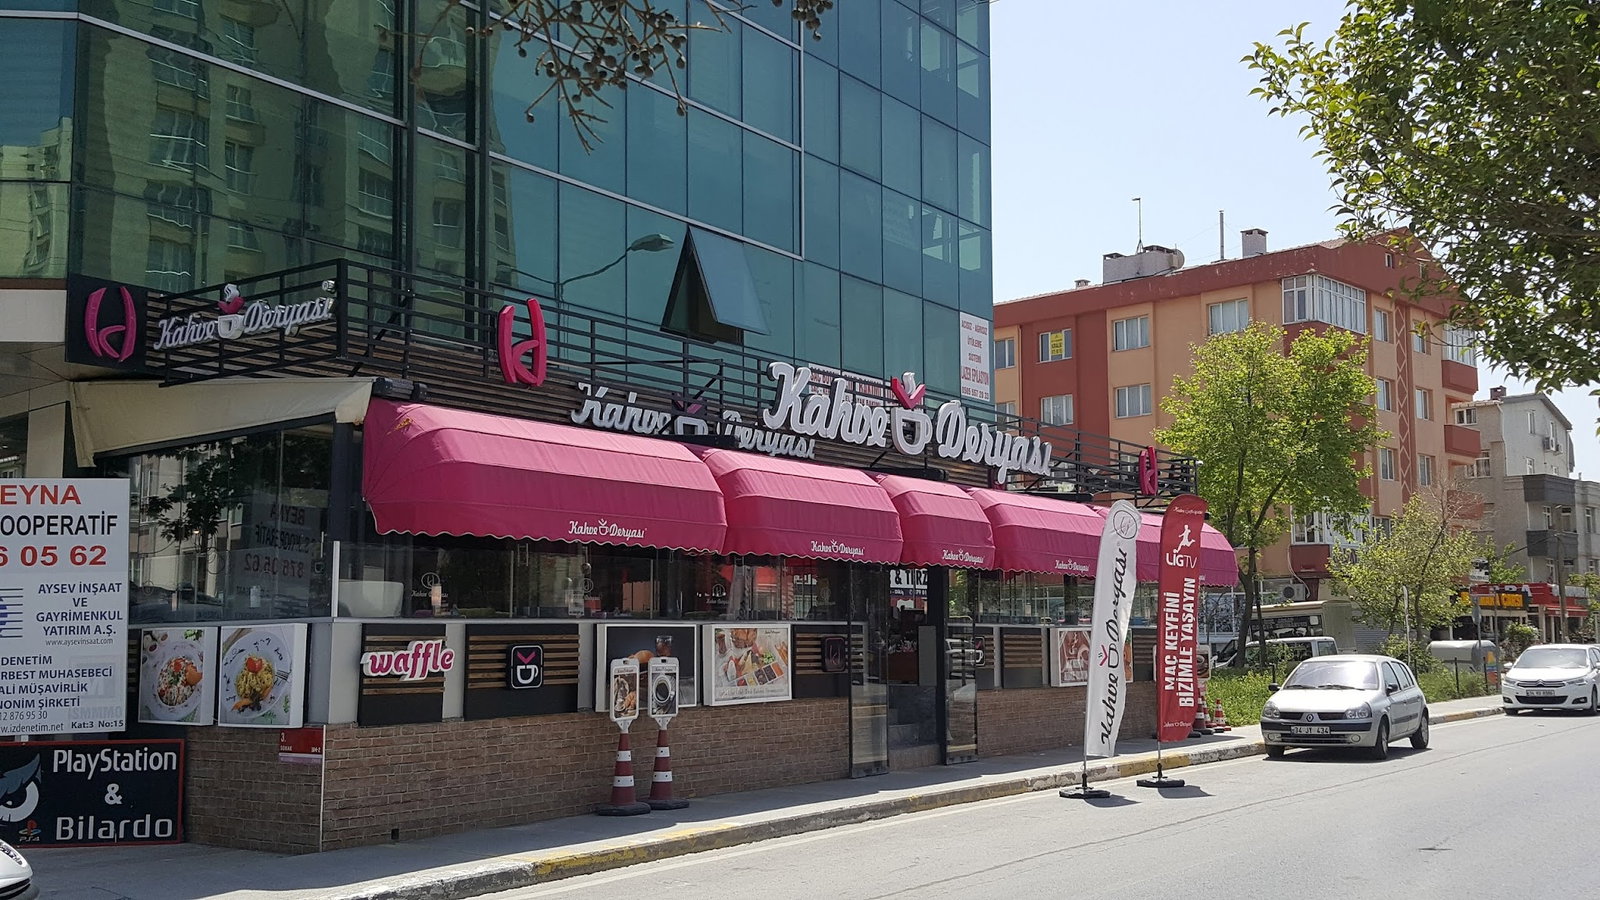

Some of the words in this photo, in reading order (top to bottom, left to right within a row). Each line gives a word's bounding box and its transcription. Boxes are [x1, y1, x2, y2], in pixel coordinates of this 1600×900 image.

[153, 313, 217, 350] Kahve
[243, 296, 334, 337] Deryası
[762, 361, 890, 448] Kahve
[936, 399, 1052, 485] Deryası
[568, 520, 598, 536] Kahve
[609, 523, 646, 541] Deryası
[20, 545, 58, 567] 05
[69, 545, 107, 566] 62
[810, 540, 833, 553] Kahve
[838, 543, 865, 558] Deryası
[38, 583, 76, 594] AYSEV
[79, 581, 123, 596] İNŞAAT
[72, 597, 88, 608] VE
[1180, 577, 1196, 643] YAŞAYIN
[36, 609, 123, 622] GAYRİMENKUL
[1163, 591, 1180, 651] KEYFİNİ
[43, 625, 91, 636] YATIRIM
[94, 624, 117, 637] A.Ş.
[45, 638, 114, 647] www.aysevinsaat.com
[1, 653, 52, 666] DENETİM
[365, 641, 455, 680] waffle
[39, 666, 113, 679] MUHASEBECİ
[1164, 654, 1179, 691] MAÇ
[1176, 646, 1194, 708] BİZİMLE
[18, 681, 88, 696] MÜŞAVİRLİK
[38, 695, 81, 710] ŞİRKETİ
[9, 711, 25, 721] 876
[26, 711, 36, 720] 95
[38, 710, 48, 719] 30
[71, 721, 94, 729] Kat:3
[98, 720, 124, 728] No:15
[53, 747, 177, 780] PlayStation
[104, 783, 122, 805] &
[56, 814, 173, 841] Bilardo
